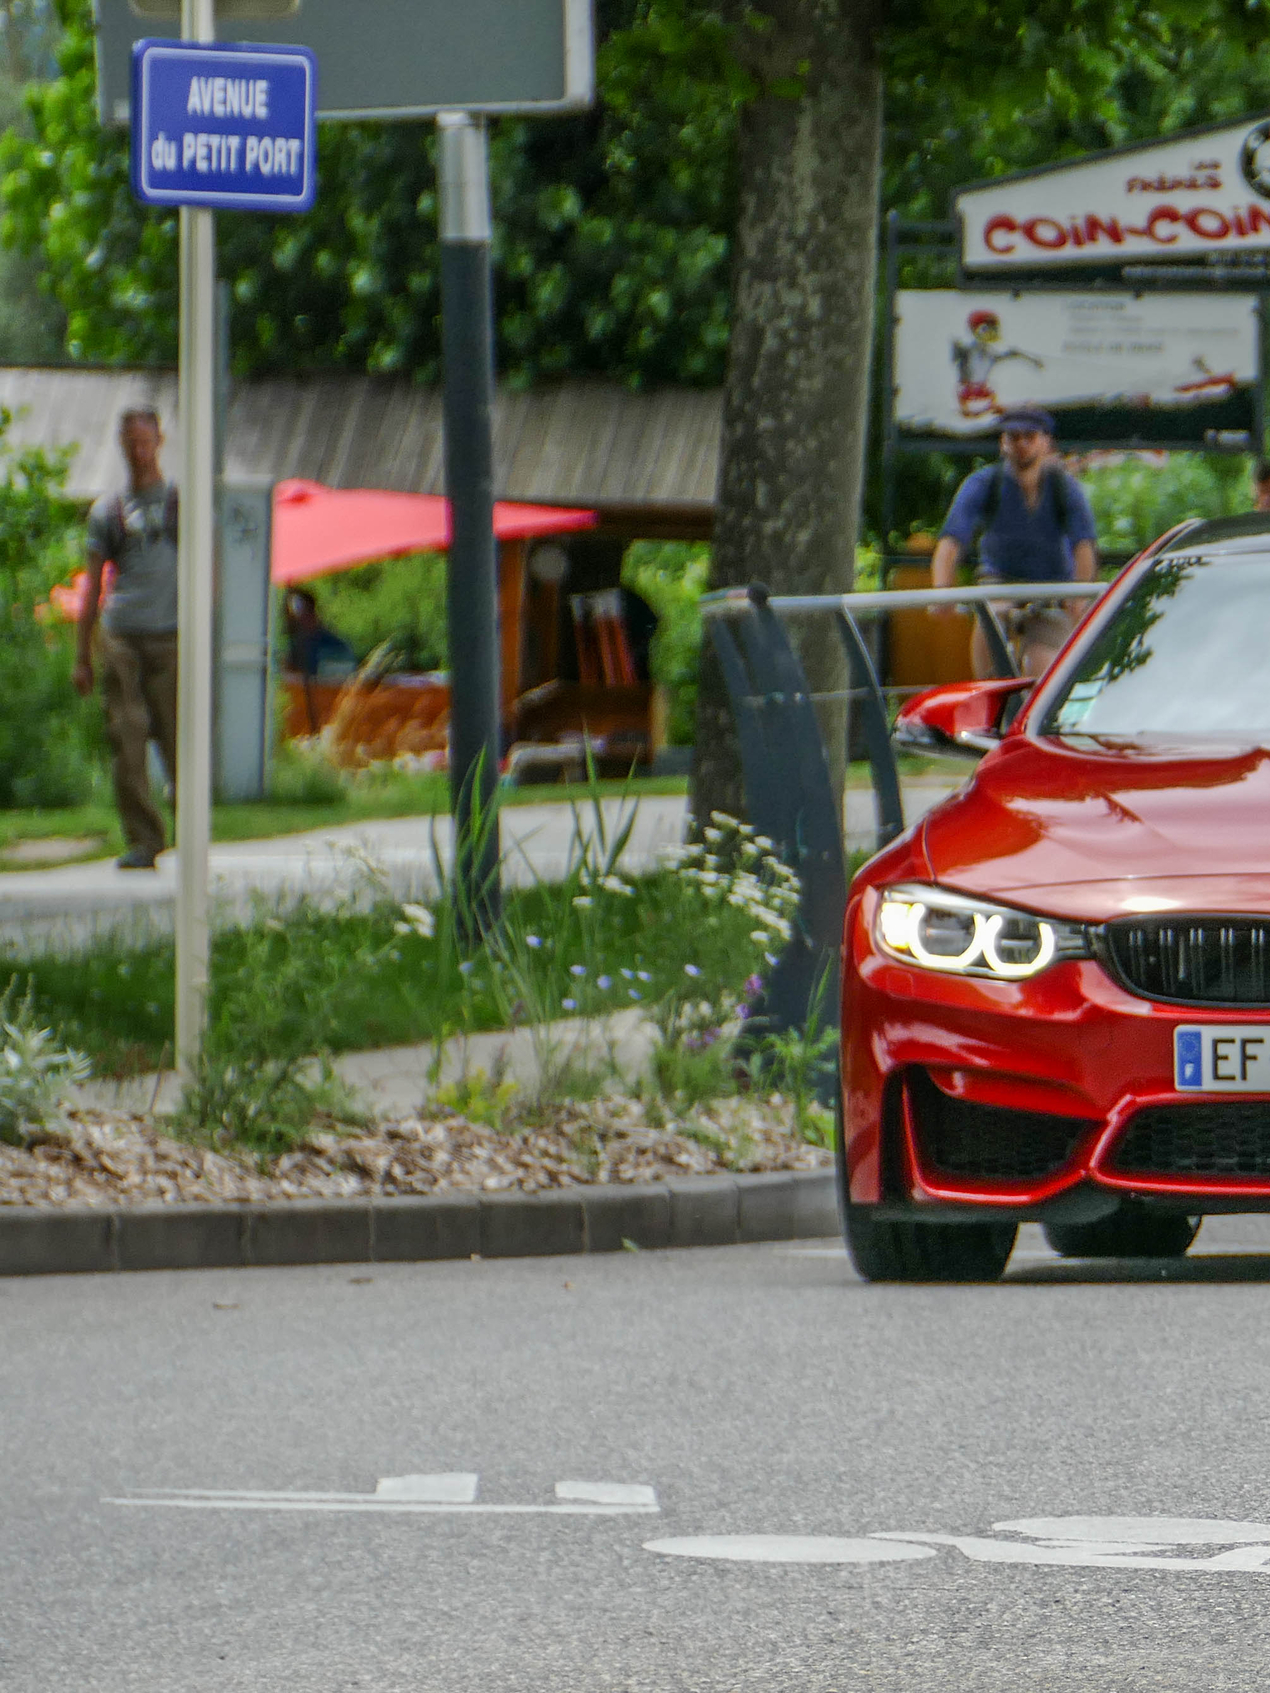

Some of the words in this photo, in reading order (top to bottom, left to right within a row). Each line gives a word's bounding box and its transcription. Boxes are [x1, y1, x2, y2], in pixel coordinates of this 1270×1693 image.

[187, 76, 269, 119] AVENUE
[151, 131, 177, 171] du
[182, 132, 241, 174] PETIT
[246, 135, 301, 177] PORT
